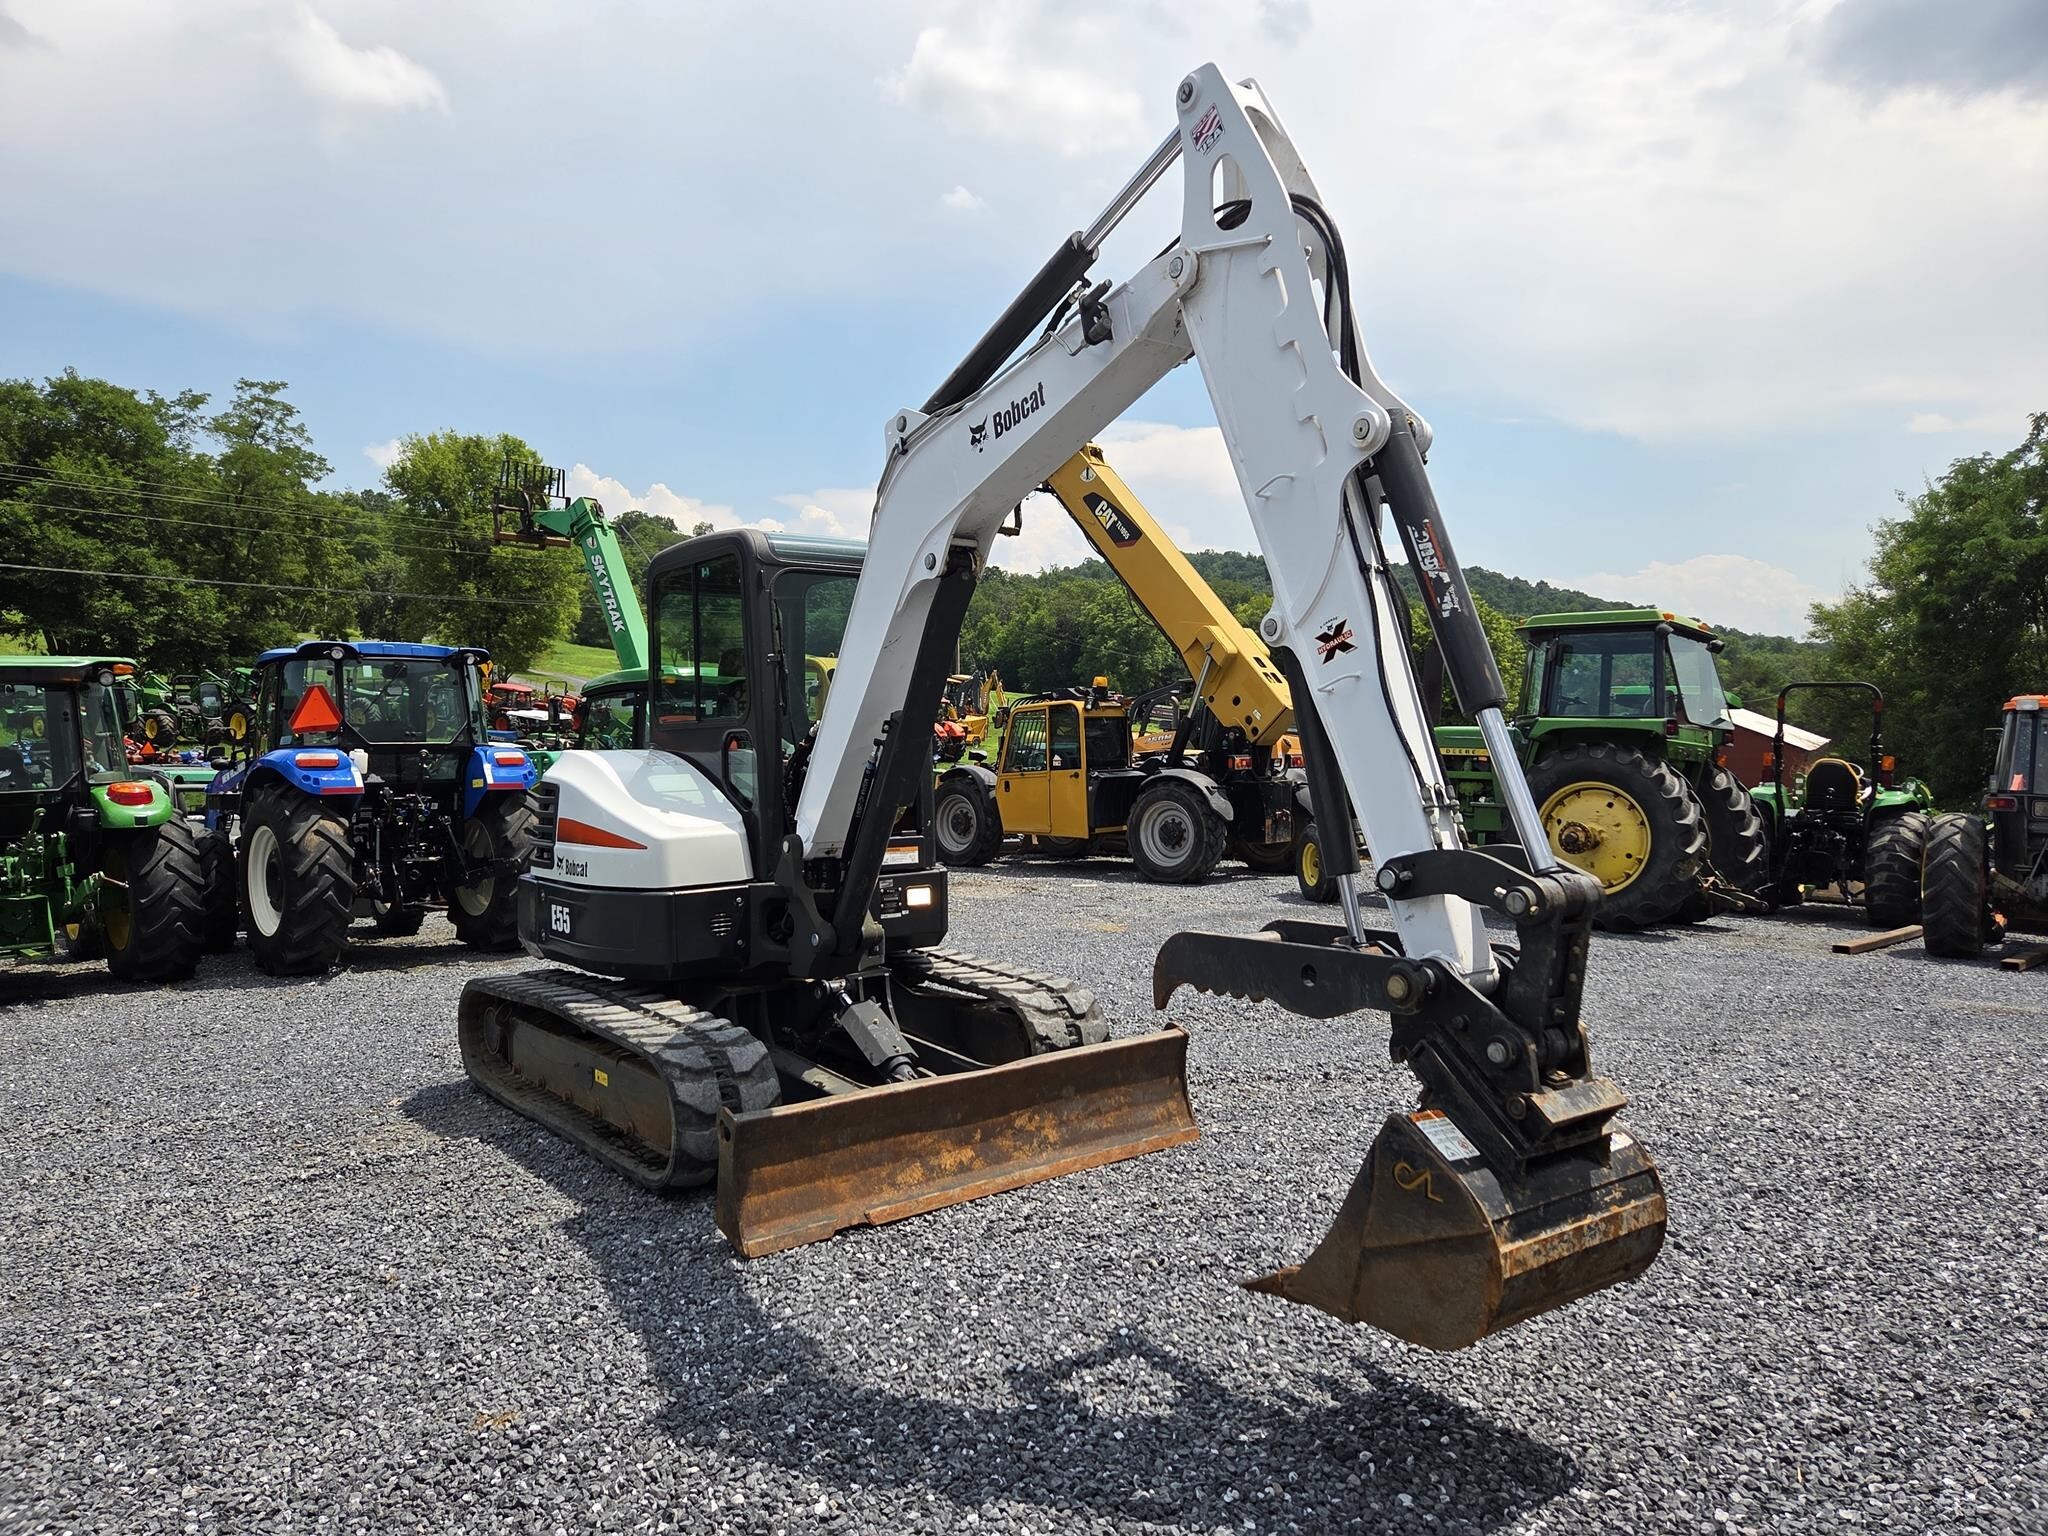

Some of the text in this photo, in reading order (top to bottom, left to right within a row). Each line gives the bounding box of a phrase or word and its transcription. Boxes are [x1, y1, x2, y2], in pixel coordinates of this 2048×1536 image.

[992, 381, 1046, 440] Bobcat
[1094, 500, 1118, 530] CAT
[591, 554, 626, 633] SKYTRAK
[1317, 630, 1352, 654] HYDRAULIC
[565, 858, 588, 878] Bobcat
[551, 903, 571, 934] E55
